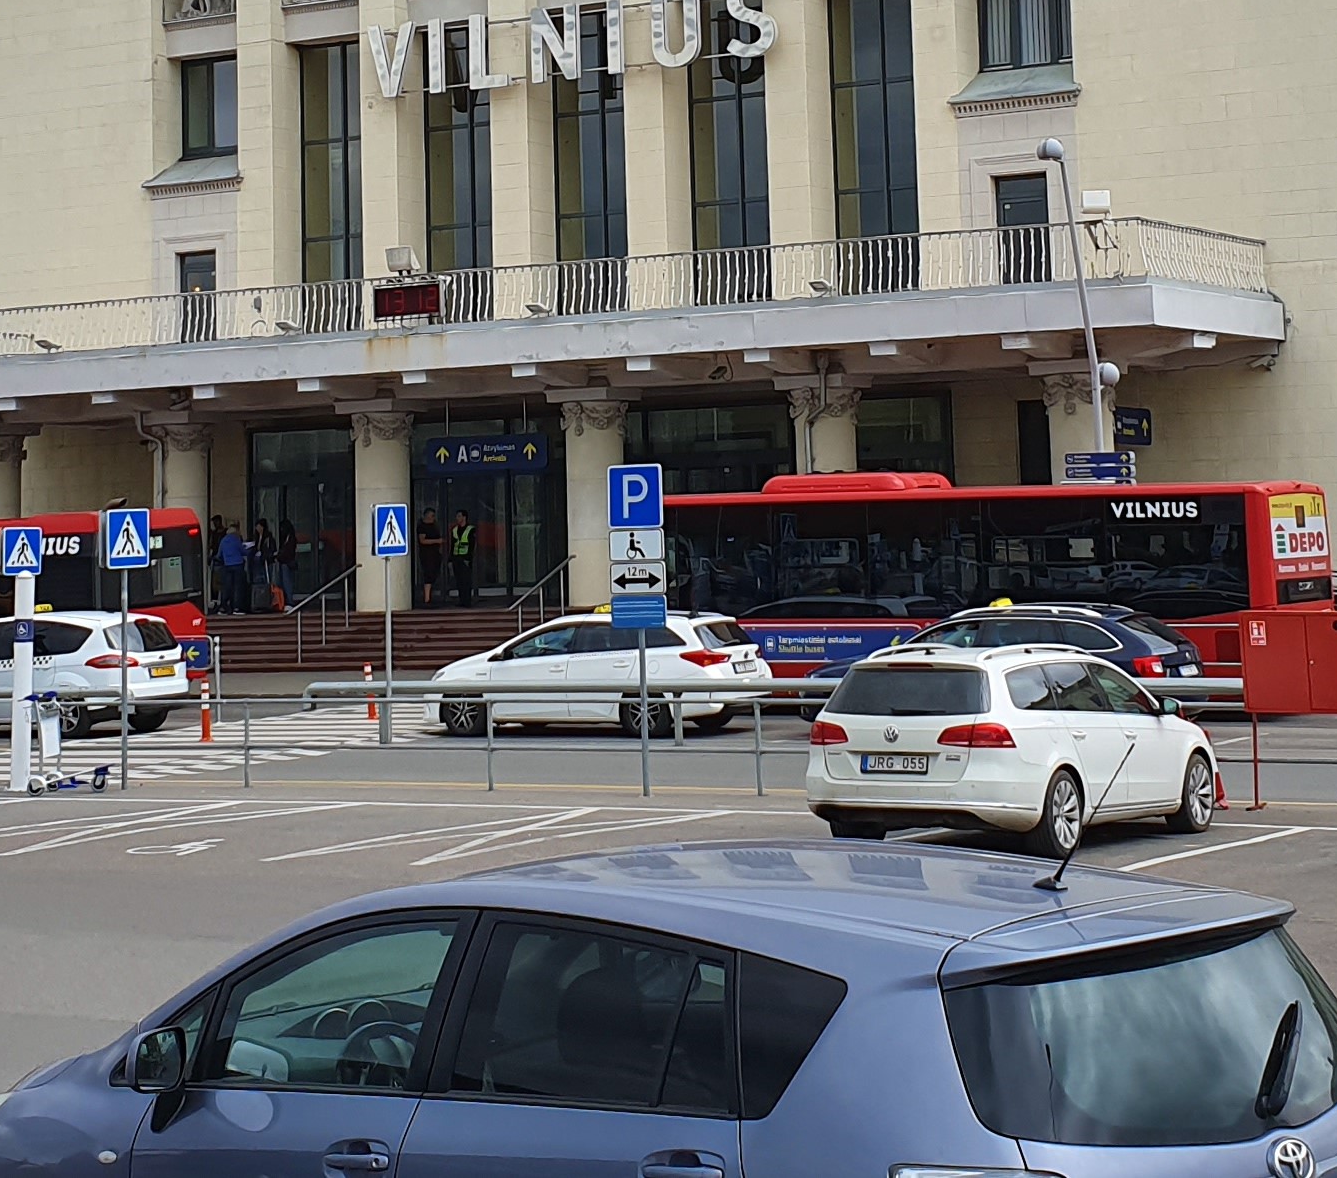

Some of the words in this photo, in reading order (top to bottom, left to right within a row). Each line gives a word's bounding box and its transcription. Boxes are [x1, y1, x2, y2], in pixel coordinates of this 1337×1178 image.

[457, 444, 468, 463] A
[622, 474, 649, 519] P
[1110, 501, 1198, 519] VILNIUS
[1288, 530, 1325, 553] DEPO
[869, 757, 894, 769] JRG
[903, 757, 925, 769] 055
